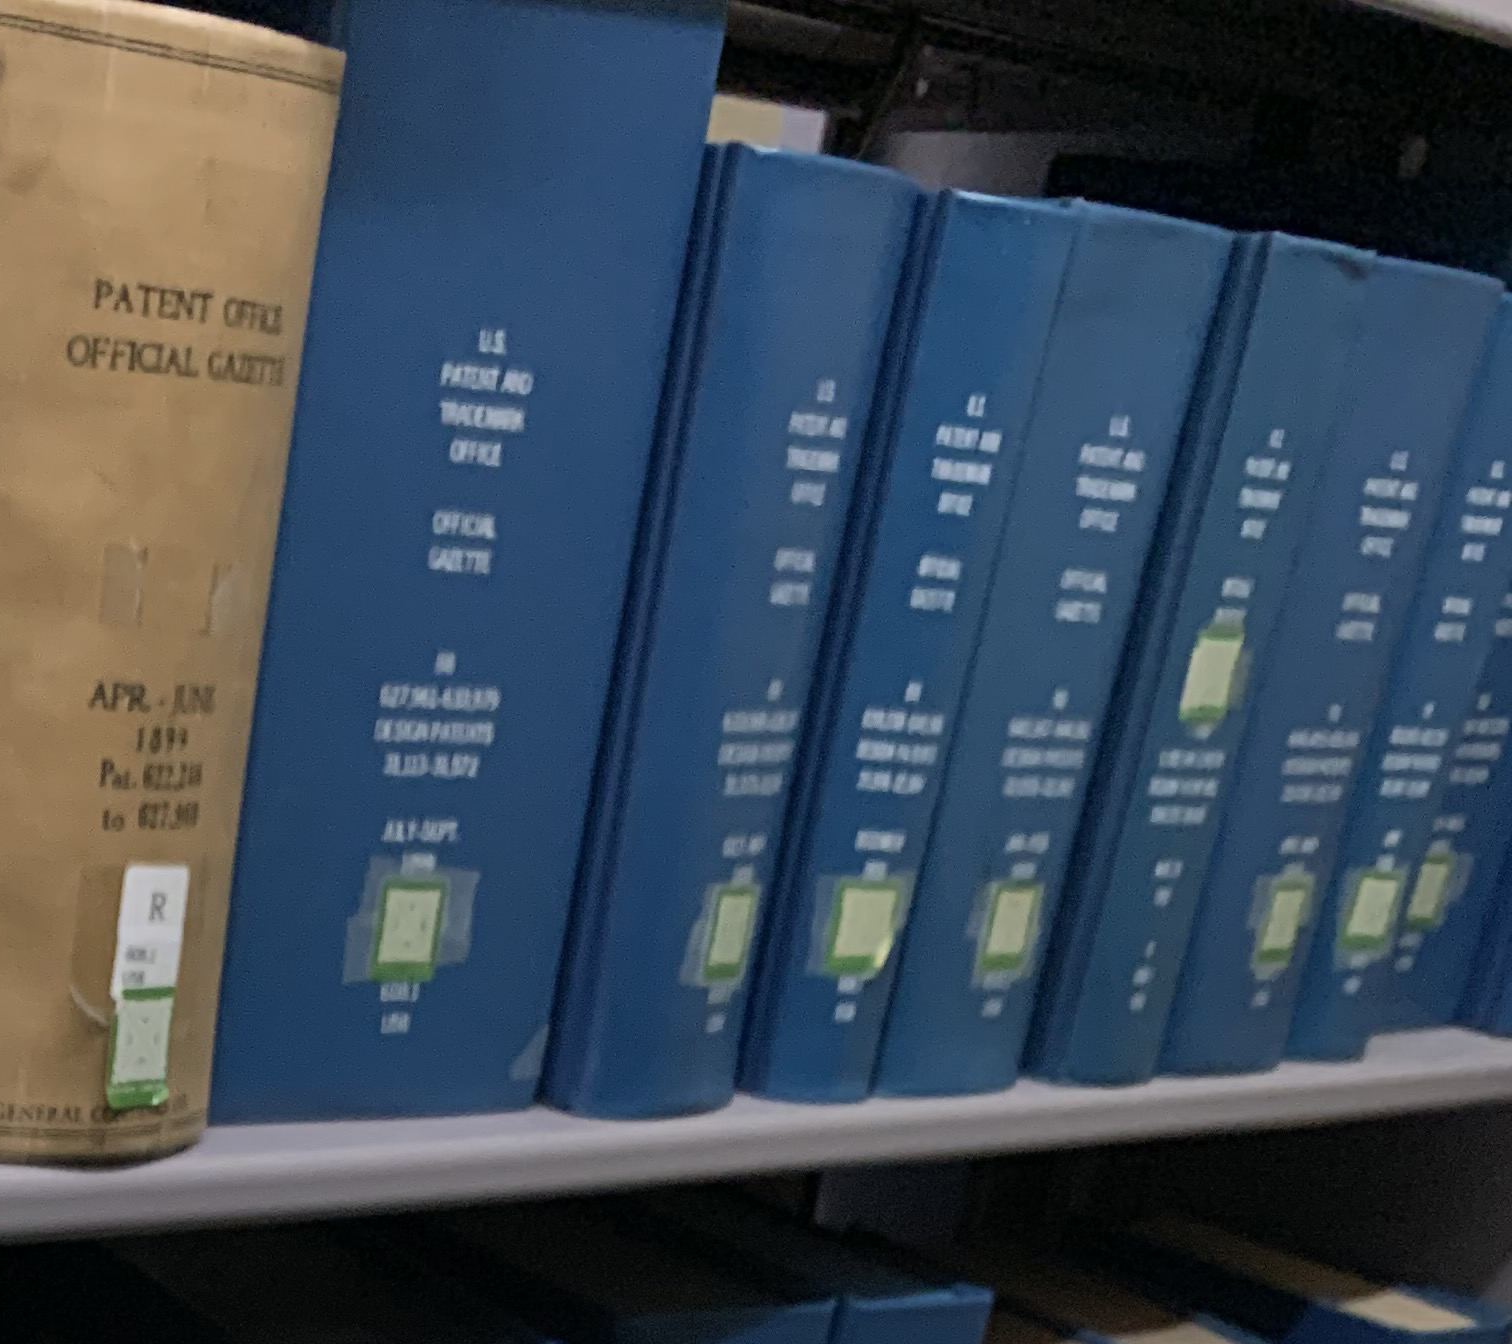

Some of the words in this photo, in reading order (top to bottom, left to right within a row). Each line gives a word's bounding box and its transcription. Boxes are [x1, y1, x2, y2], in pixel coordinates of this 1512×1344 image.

[94, 278, 213, 324] PATENT
[67, 335, 199, 378] OFFICIAL
[149, 892, 167, 922] R
